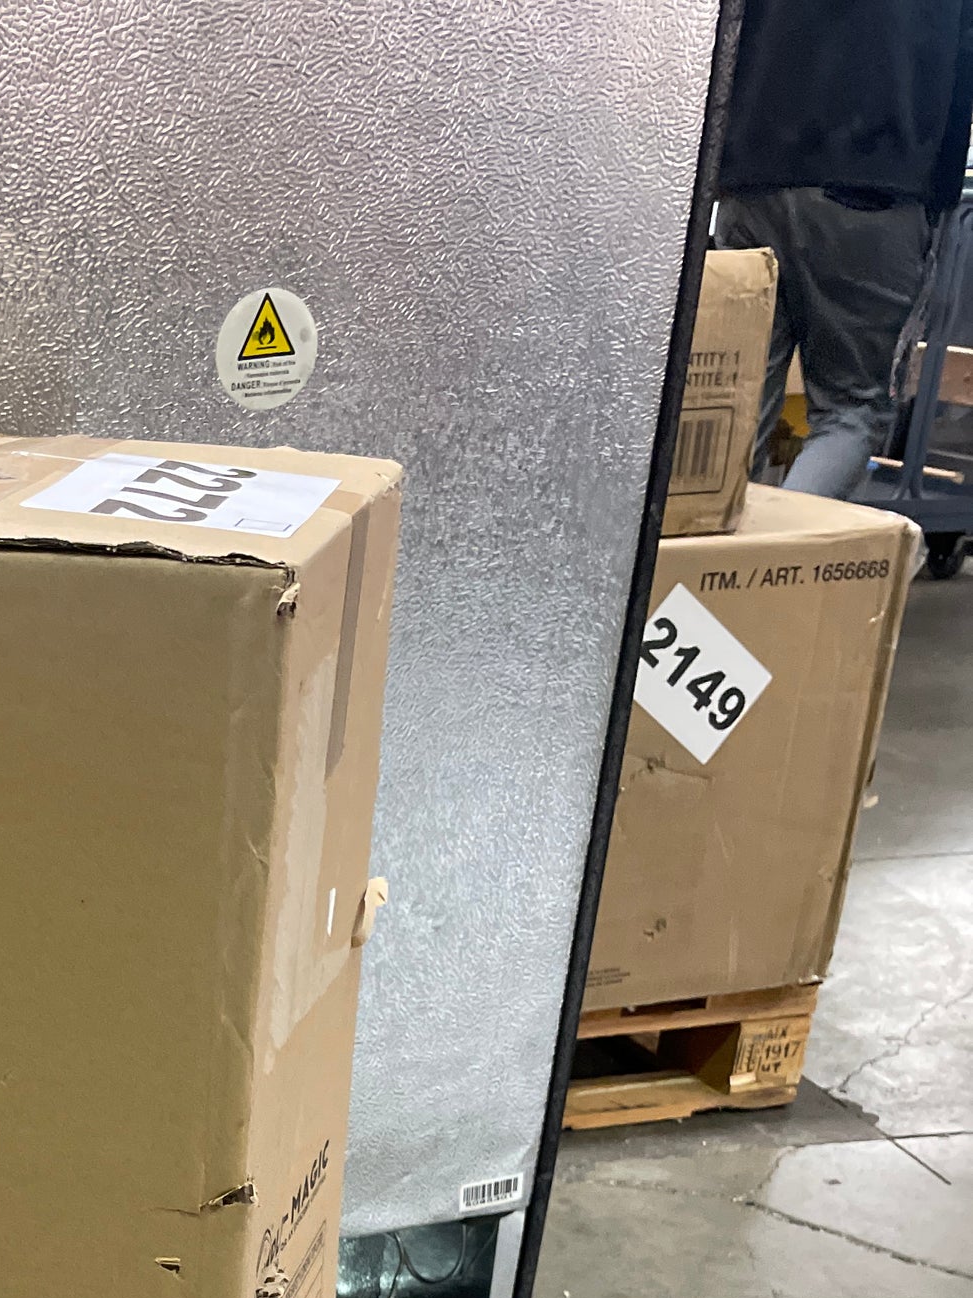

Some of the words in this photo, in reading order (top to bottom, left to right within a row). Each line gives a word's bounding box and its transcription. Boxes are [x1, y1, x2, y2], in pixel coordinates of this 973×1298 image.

[237, 359, 270, 371] WARNING
[231, 380, 261, 391] DANGER
[90, 460, 257, 523] 2272
[699, 571, 741, 591] ITM.
[746, 568, 758, 588] /
[760, 565, 805, 588] ART.
[813, 559, 890, 583] 1656668
[640, 617, 746, 731] 2149
